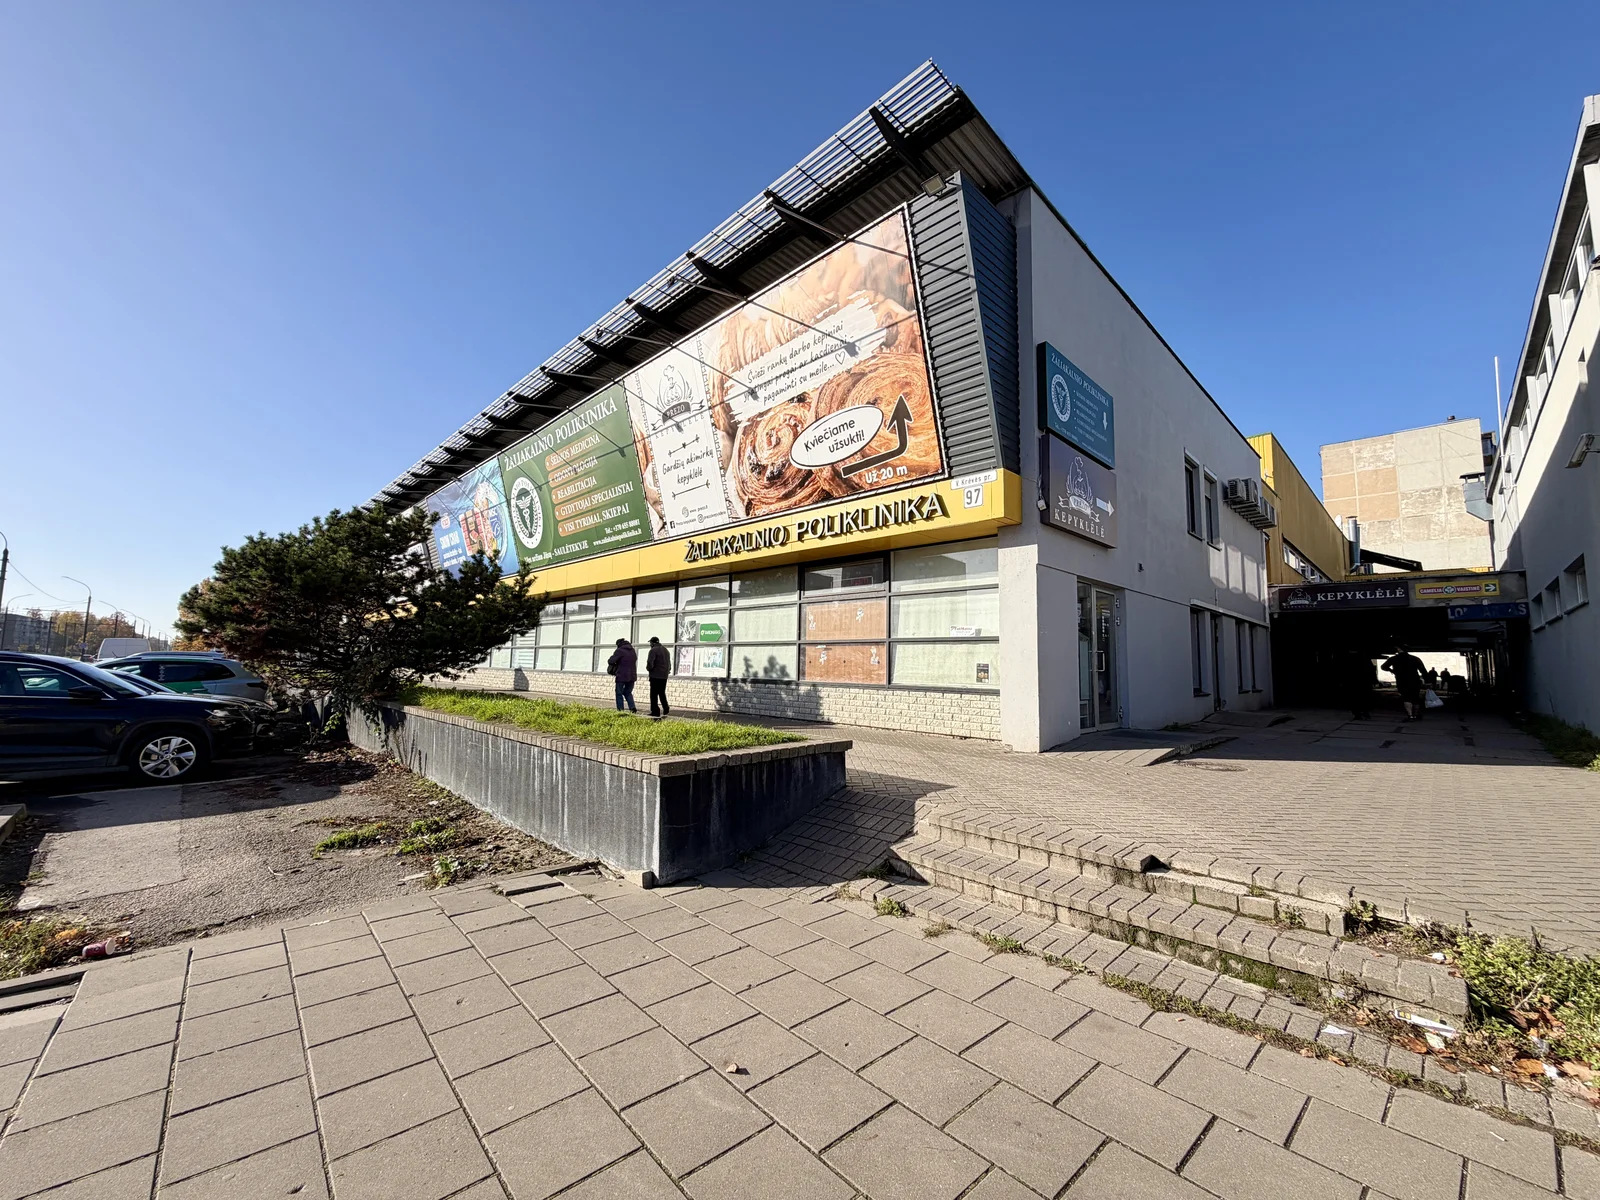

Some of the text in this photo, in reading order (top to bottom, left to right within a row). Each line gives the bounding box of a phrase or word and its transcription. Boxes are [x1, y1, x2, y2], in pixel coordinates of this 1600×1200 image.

[767, 354, 788, 372] rankų
[789, 342, 811, 360] darbo
[813, 320, 843, 346] kepiniai
[799, 358, 808, 369] ar
[763, 379, 797, 406] pagaminti
[666, 405, 685, 418] PREZO
[504, 397, 618, 472] ŽALIAKALNIO POLIKLINIKA
[570, 434, 601, 457] MEDICINA
[804, 419, 856, 452] Kviečiame
[828, 429, 866, 453] užsukti!
[865, 465, 908, 484] Už 20 m
[557, 476, 597, 500] REABILITACIJA
[560, 481, 634, 516] GYDYTOJAI SPECIALISTAI
[965, 488, 981, 505] 97
[602, 502, 630, 521] SKIEPAI
[1054, 508, 1105, 538] KEPYKLĖLĖ
[684, 492, 945, 562] ŽALIAKALNIO POLIKLINIKA
[1317, 586, 1405, 601] KEPYKLĖLĖ
